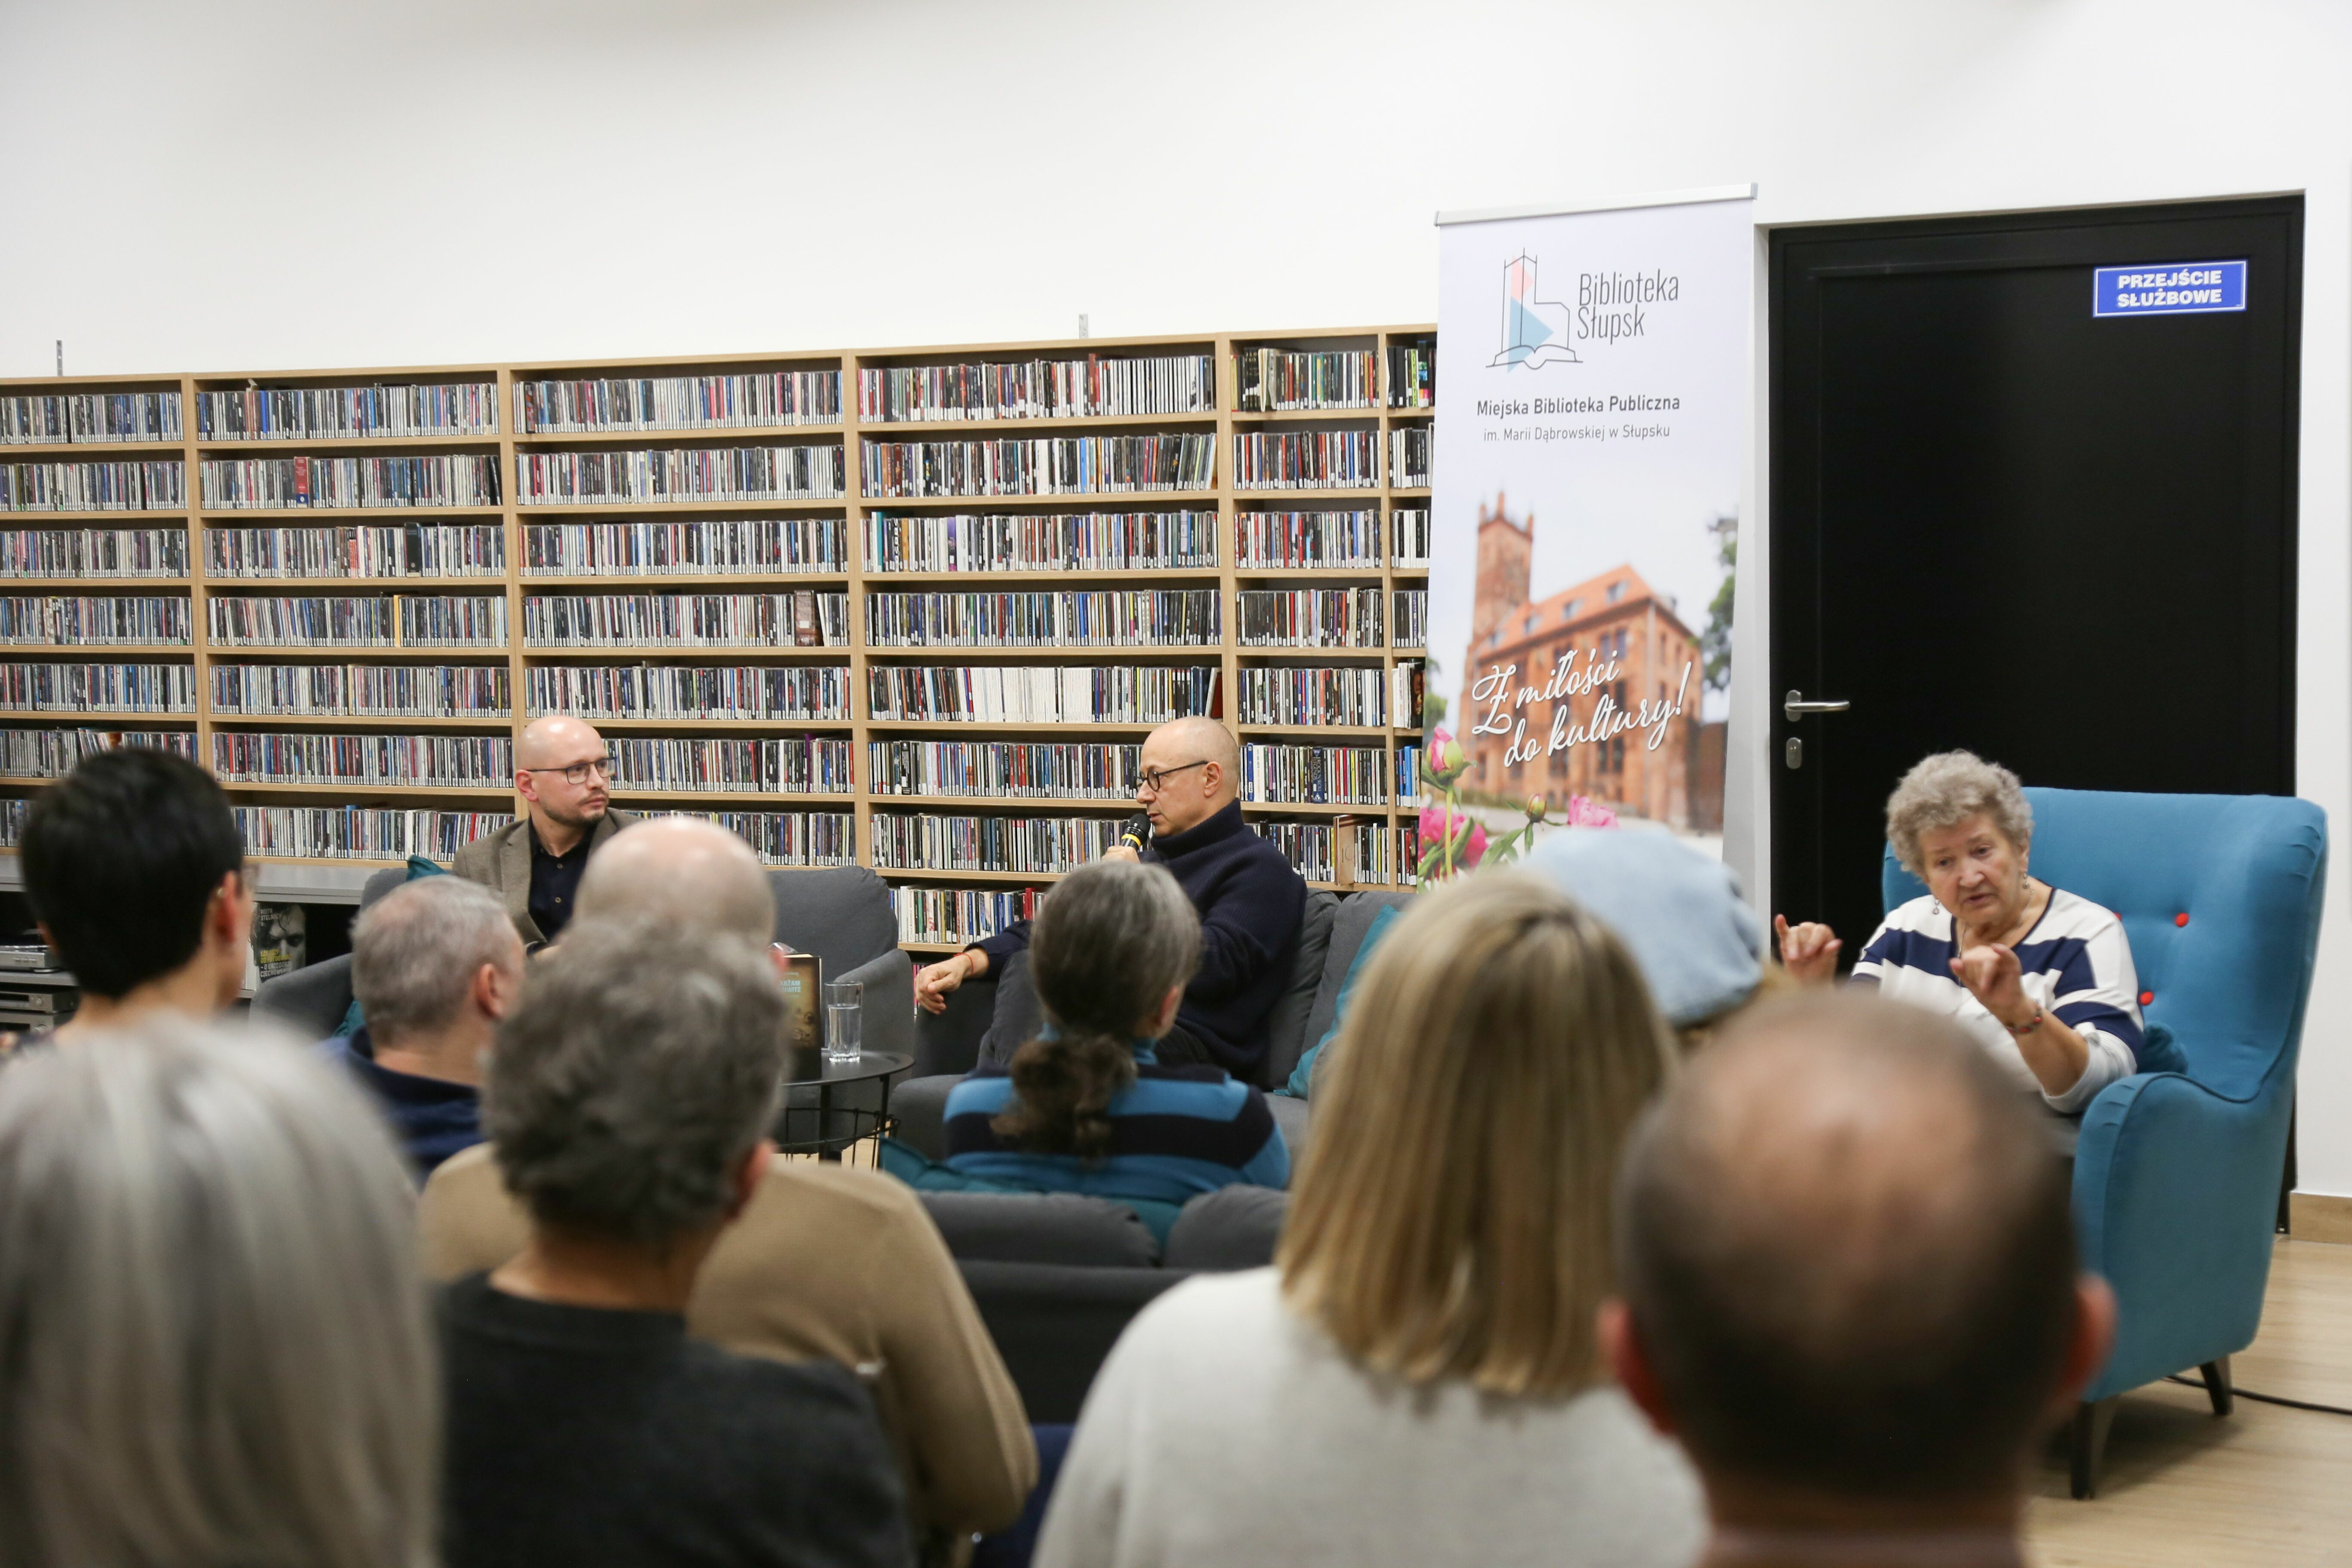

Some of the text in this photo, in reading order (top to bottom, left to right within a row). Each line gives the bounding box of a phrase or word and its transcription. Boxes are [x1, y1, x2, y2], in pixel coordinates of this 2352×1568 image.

[1579, 268, 1679, 307] Biblioteka
[2118, 268, 2222, 289] PRZEJŚCIE
[2117, 288, 2222, 307] SŁUŻBOWE
[1577, 303, 1645, 345] Słupsk
[1477, 394, 1680, 420] Miejska Biblioteka Publiczna
[1484, 423, 1670, 443] im. Marii Dąbrowskiej w Słupsku
[1472, 665, 1516, 735] Z
[1516, 648, 1619, 709] miłości
[1504, 661, 1692, 767] do kultury!
